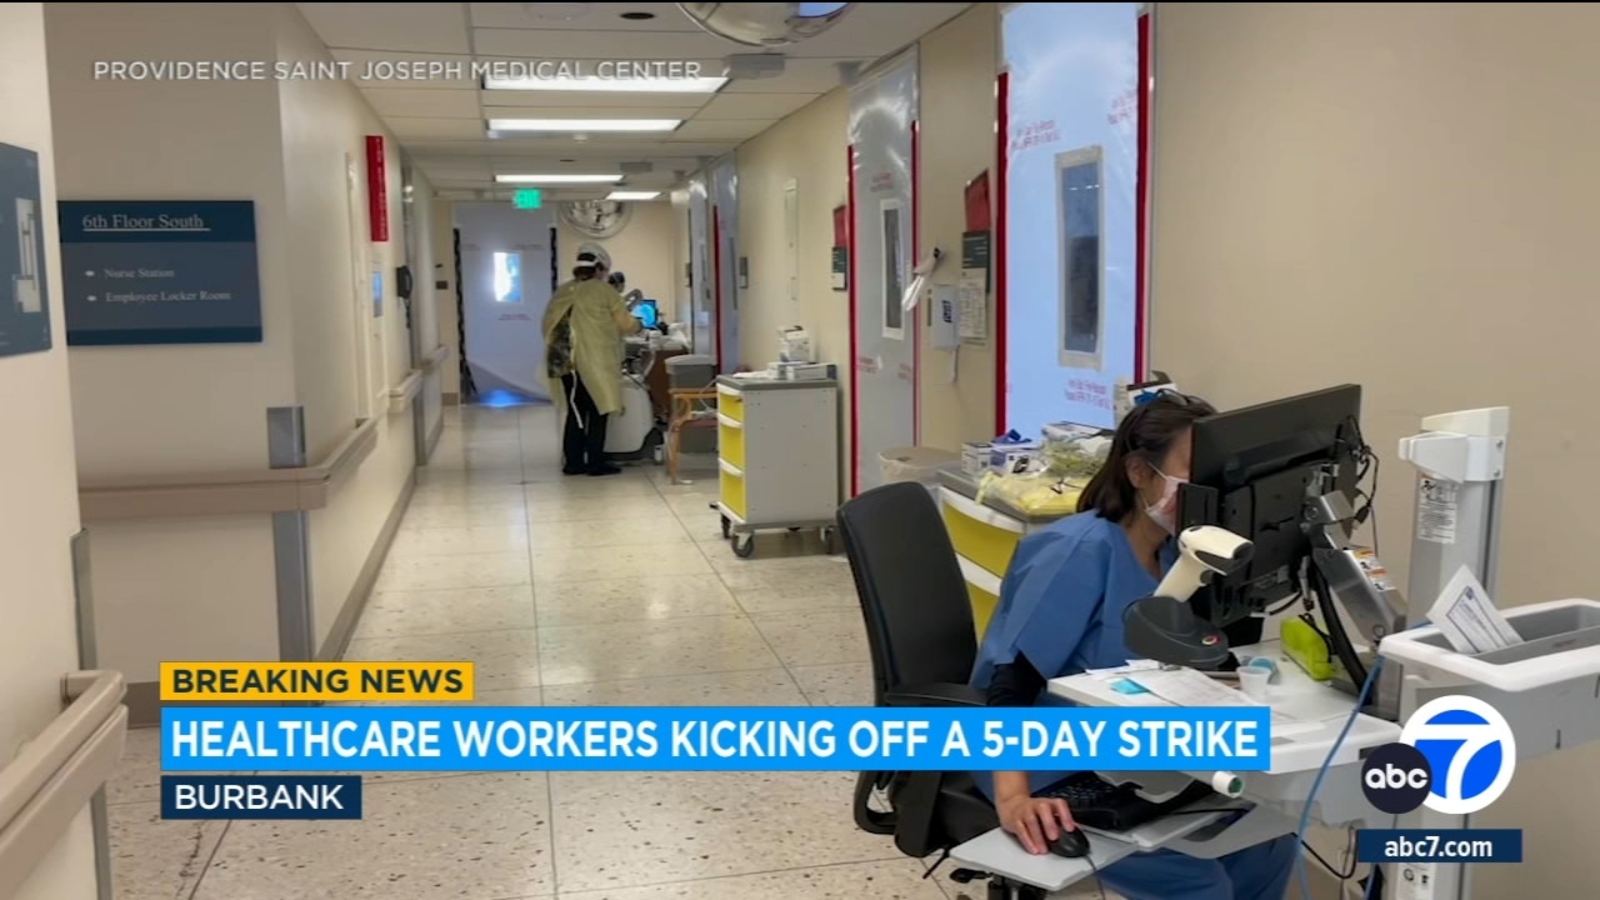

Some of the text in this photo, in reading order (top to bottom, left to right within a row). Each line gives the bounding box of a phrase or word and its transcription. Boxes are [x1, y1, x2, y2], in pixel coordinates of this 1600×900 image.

[82, 214, 204, 229] 6th Floor South
[104, 268, 175, 279] Nurse Station
[105, 290, 231, 304] Employee Locker Room
